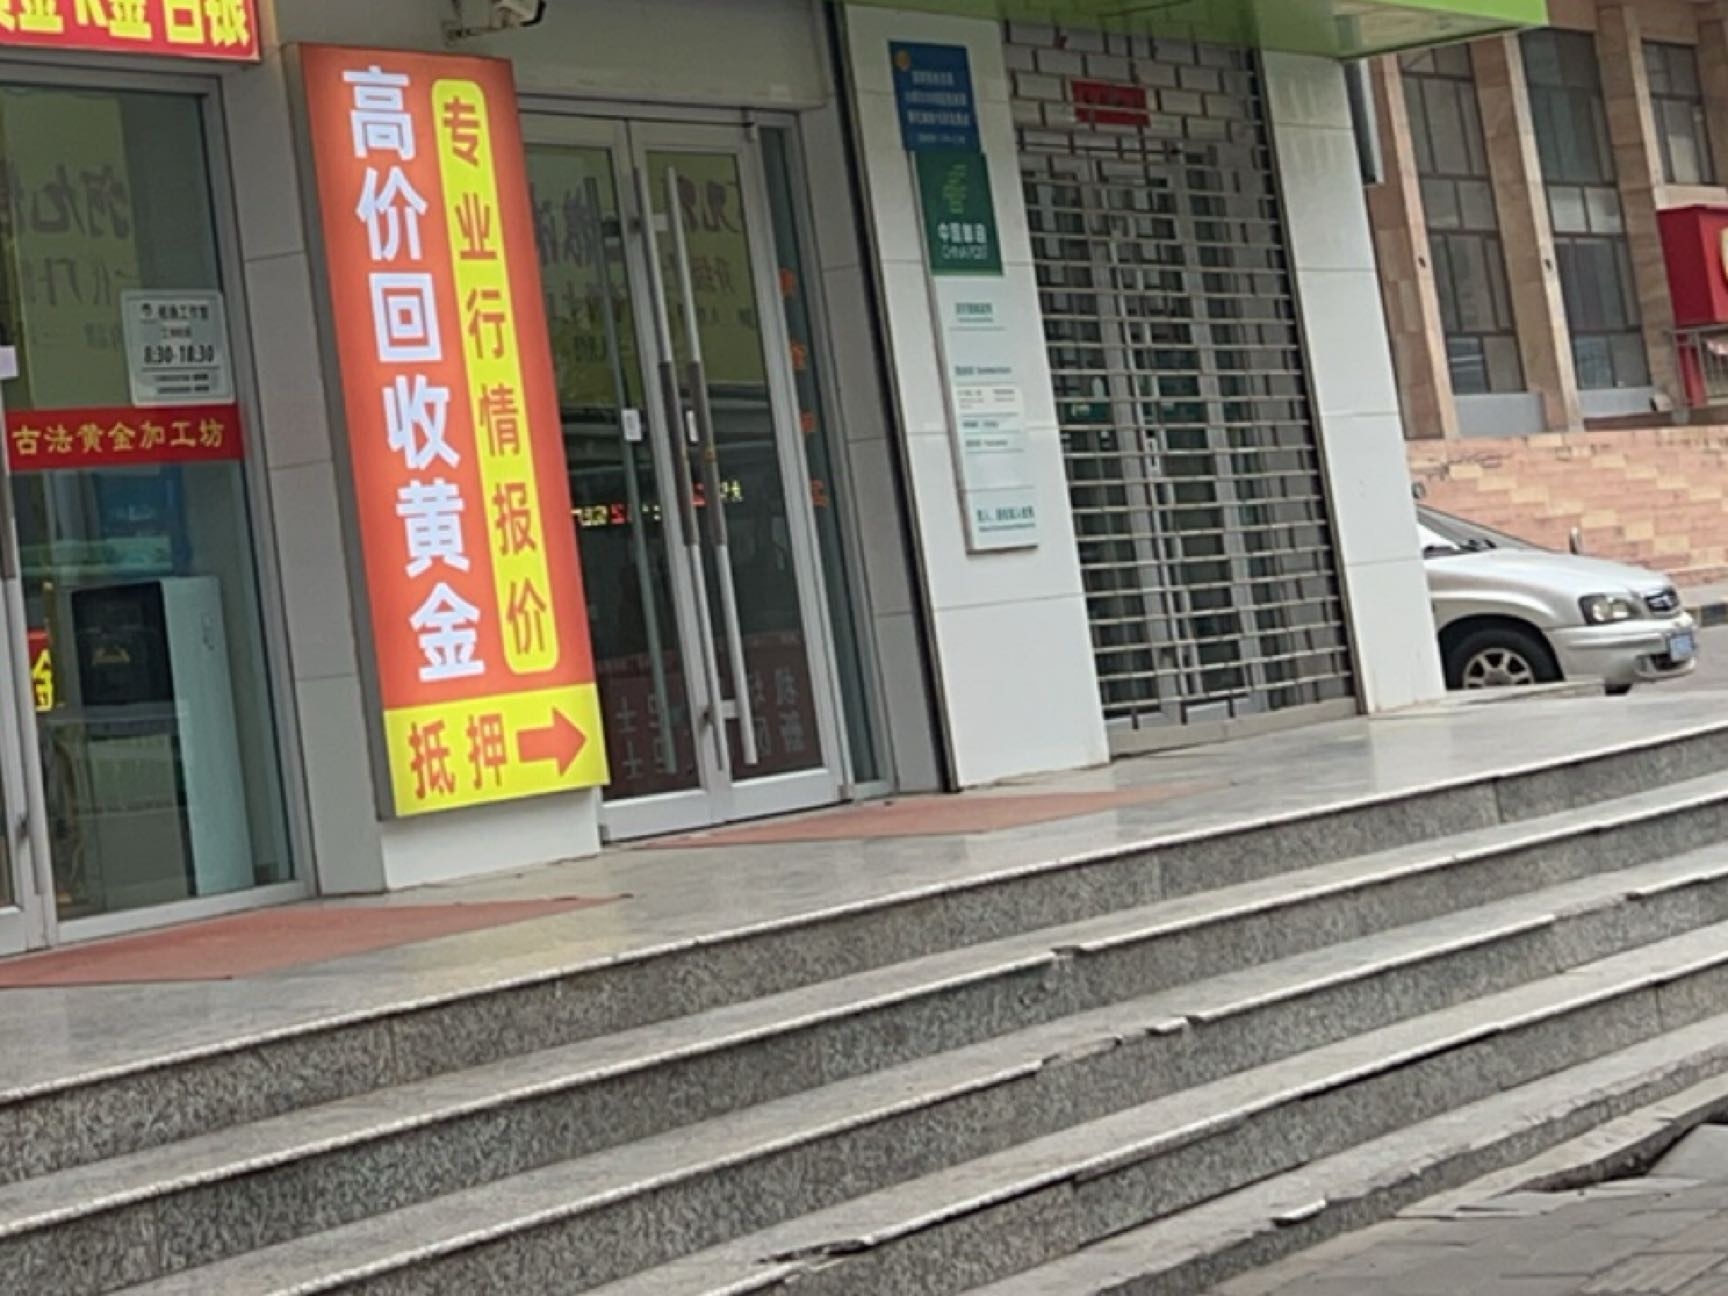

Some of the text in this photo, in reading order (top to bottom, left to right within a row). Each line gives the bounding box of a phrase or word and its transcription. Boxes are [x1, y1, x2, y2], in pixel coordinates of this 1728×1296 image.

[11, 417, 226, 456] 古法黄金加工坊
[342, 65, 486, 684] 高价回收黄金
[442, 95, 549, 659] 专业行情报价
[408, 713, 508, 802] 抵押
